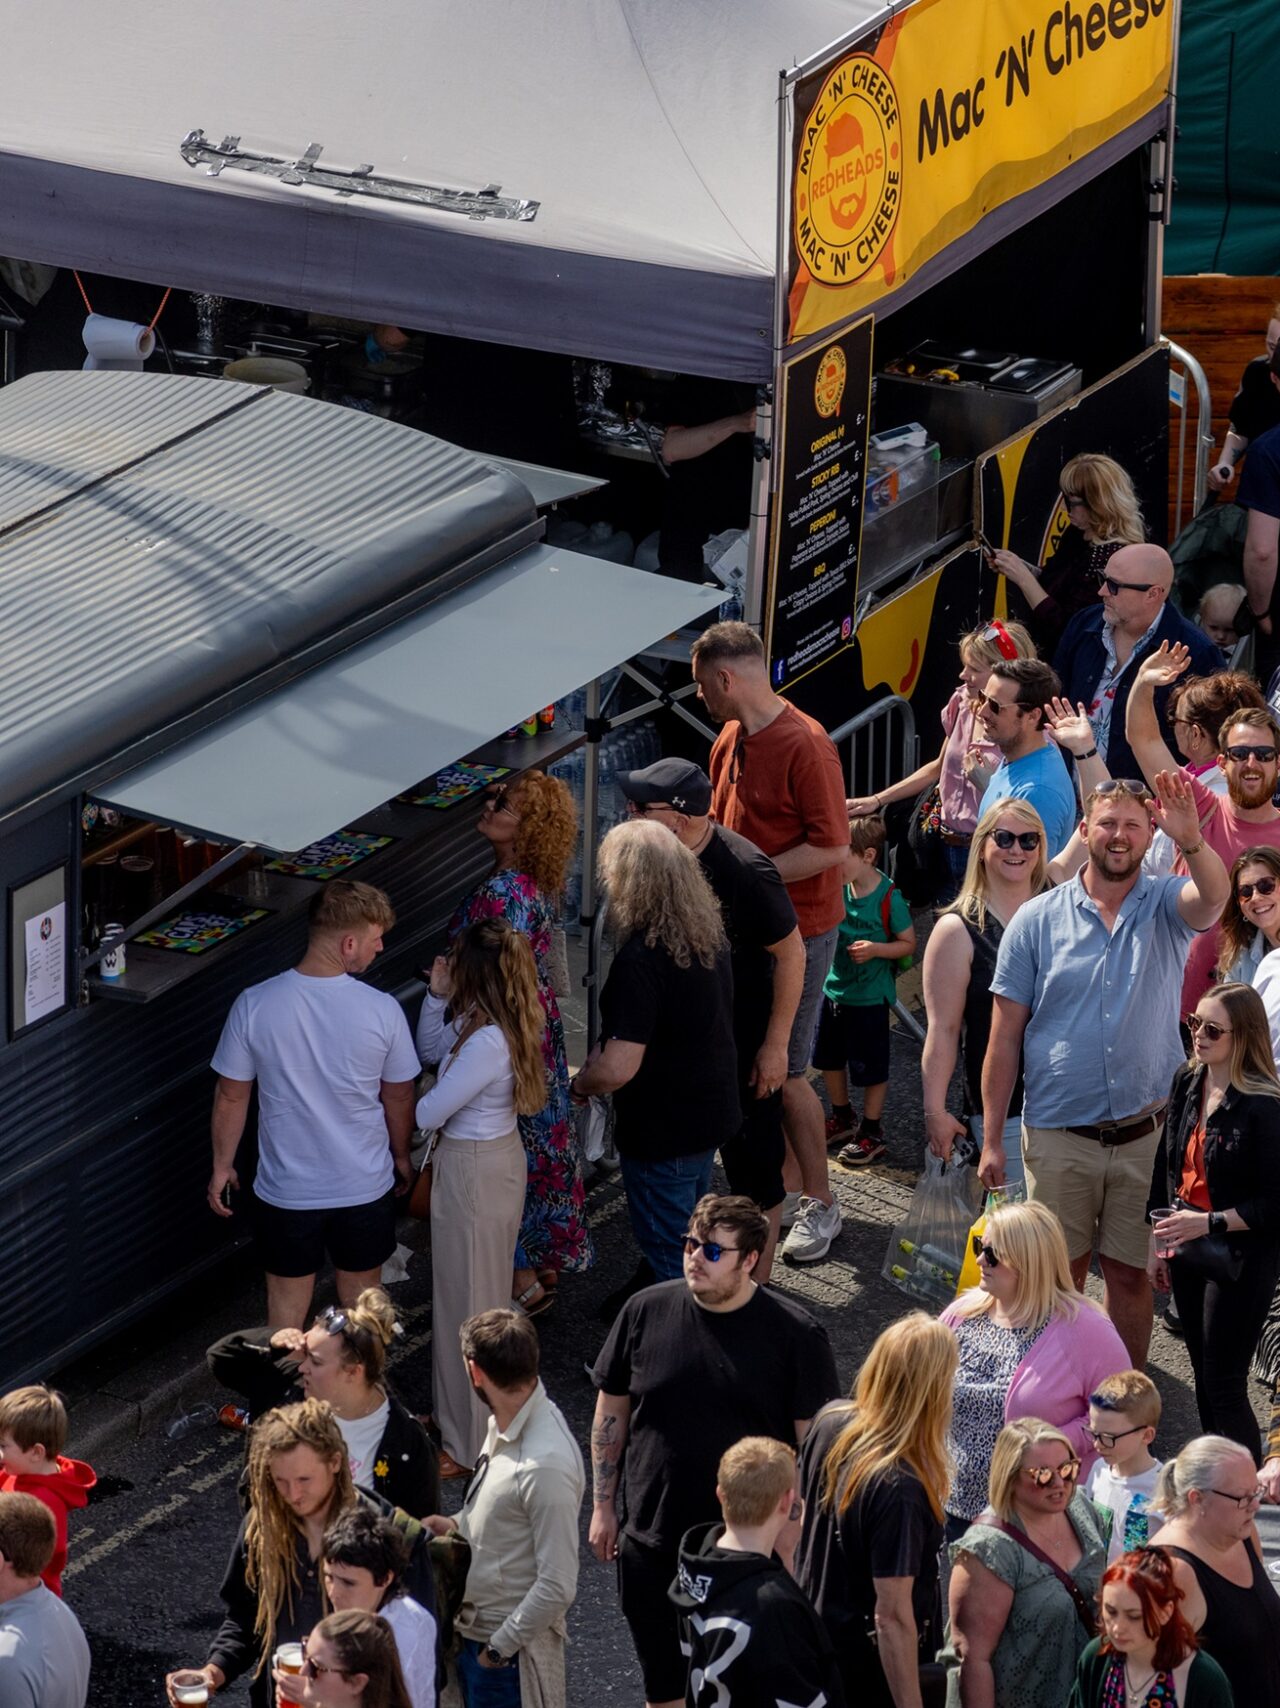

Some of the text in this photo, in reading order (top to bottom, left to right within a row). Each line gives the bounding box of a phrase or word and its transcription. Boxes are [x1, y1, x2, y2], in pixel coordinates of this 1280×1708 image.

[800, 64, 898, 175] MAC 'N' CHEESE
[918, 77, 985, 163] Mac
[995, 29, 1035, 107] 'N'
[800, 170, 899, 276] MAC 'N' CHEESE
[811, 148, 884, 202] REDHEADS
[811, 470, 831, 489] STICKY
